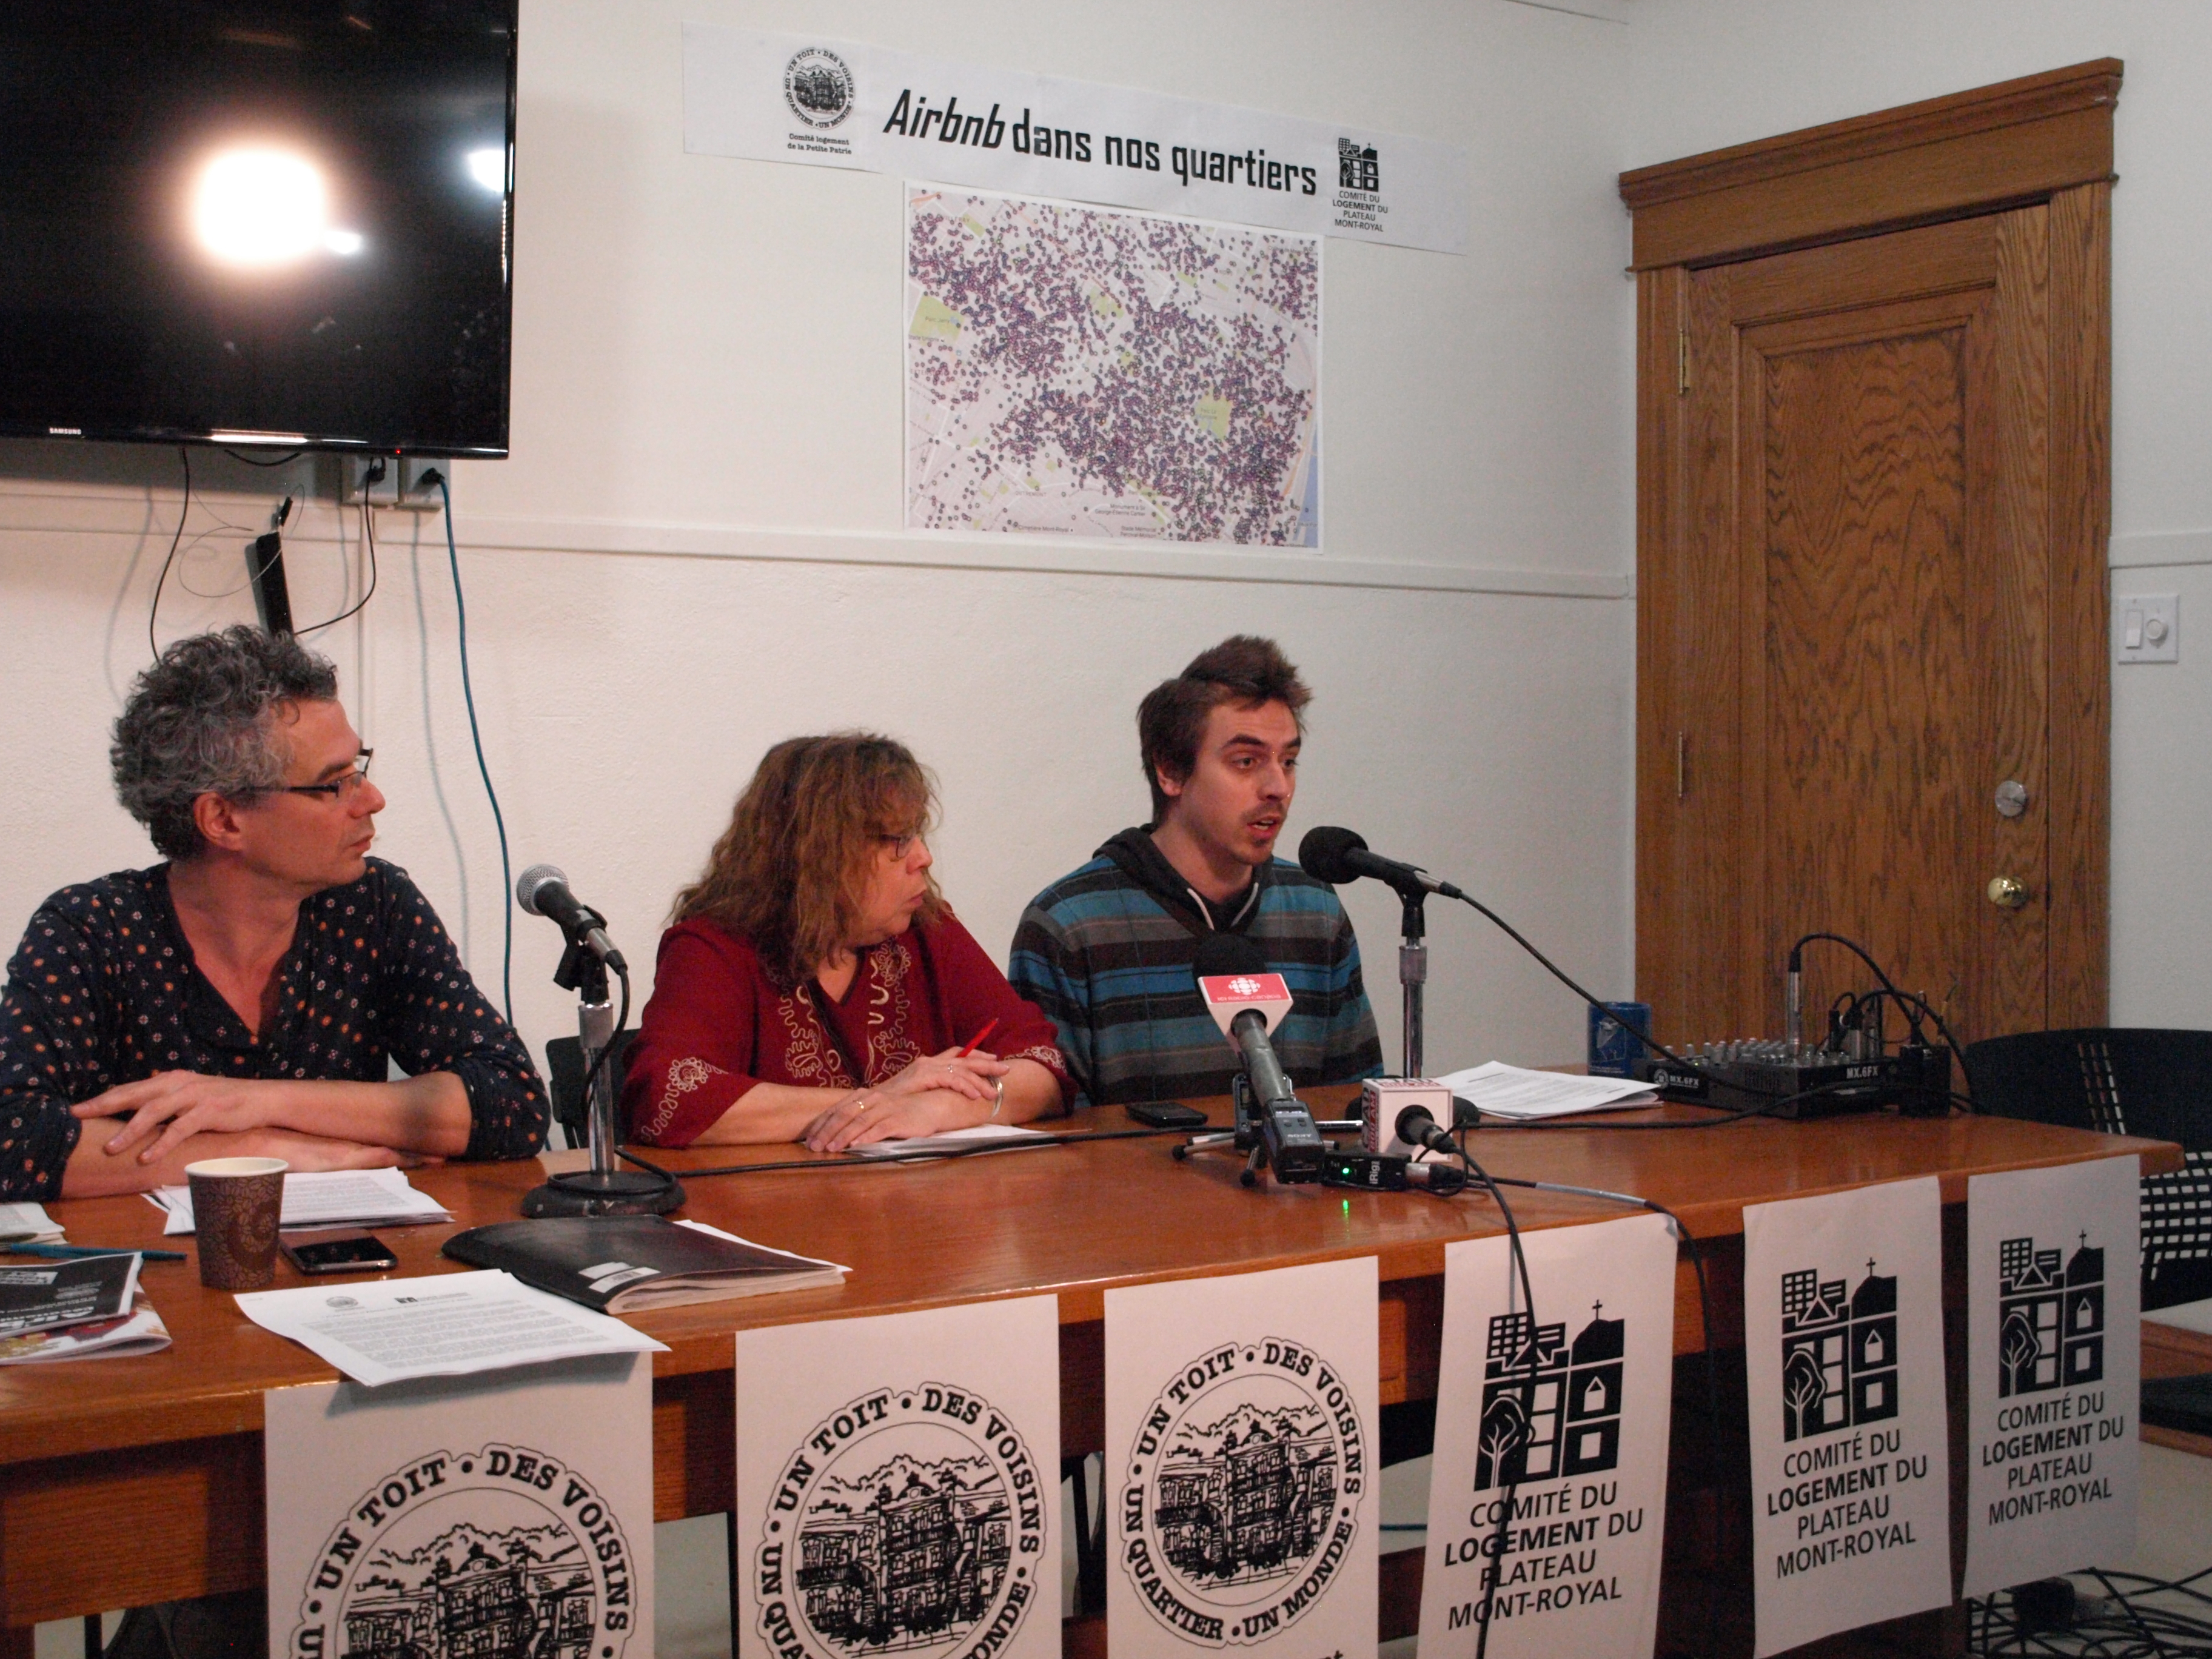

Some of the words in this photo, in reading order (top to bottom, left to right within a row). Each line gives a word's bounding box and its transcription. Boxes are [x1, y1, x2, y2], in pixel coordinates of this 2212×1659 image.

[797, 49, 815, 60] TOIT
[823, 50, 839, 63] DES
[789, 133, 814, 142] Comité
[816, 136, 850, 146] logement
[830, 146, 852, 155] Patrie
[883, 89, 1005, 150] Airbnb
[1013, 108, 1091, 163] dans
[1105, 135, 1160, 172] nos
[1171, 145, 1316, 196] quartiers
[1333, 199, 1376, 212] LOGEMENT
[1343, 210, 1376, 221] PLATEAU
[1369, 195, 1380, 203] DU
[1335, 219, 1384, 232] MONT-ROYAL
[1137, 1404, 1171, 1456] UN
[1168, 1349, 1235, 1405] TOIT
[1263, 1342, 1315, 1377] DES
[1316, 1367, 1362, 1495] VOISINS
[1998, 1393, 2071, 1432] COMITÉ
[2078, 1392, 2103, 1416] DU
[774, 1455, 814, 1512] UN
[811, 1395, 888, 1455] TOIT
[1784, 1432, 1861, 1478] COMITÉ
[1871, 1429, 1901, 1455] DU
[1983, 1423, 2093, 1467] LOGEMENT
[2099, 1416, 2123, 1441] DU
[922, 1389, 982, 1425] DES
[985, 1415, 1040, 1553] VOISINS
[1768, 1463, 1888, 1516] LOGEMENT
[1896, 1455, 1927, 1483] DU
[2008, 1452, 2092, 1490] PLATEAU
[315, 1527, 362, 1590] UN
[358, 1458, 446, 1526] TOIT
[1125, 1484, 1144, 1533] UN
[1470, 1483, 1572, 1527] COMITÉ
[1580, 1481, 1617, 1509] DU
[1798, 1495, 1890, 1540] PLATEAU
[1988, 1478, 2112, 1526] MONT-ROYAL
[486, 1450, 558, 1491] DES
[562, 1479, 629, 1631] VOISINS
[1444, 1517, 1600, 1567] LOGEMENT
[1607, 1508, 1643, 1538] DU
[1777, 1521, 1915, 1579] MONT-ROYAL
[762, 1542, 783, 1595] UN
[1127, 1538, 1224, 1640] QUARTIER
[1242, 1606, 1280, 1638] UN
[1282, 1521, 1353, 1619] MONDE
[962, 1581, 1030, 1659] ONDE
[1448, 1577, 1622, 1630] MONT-ROYAL
